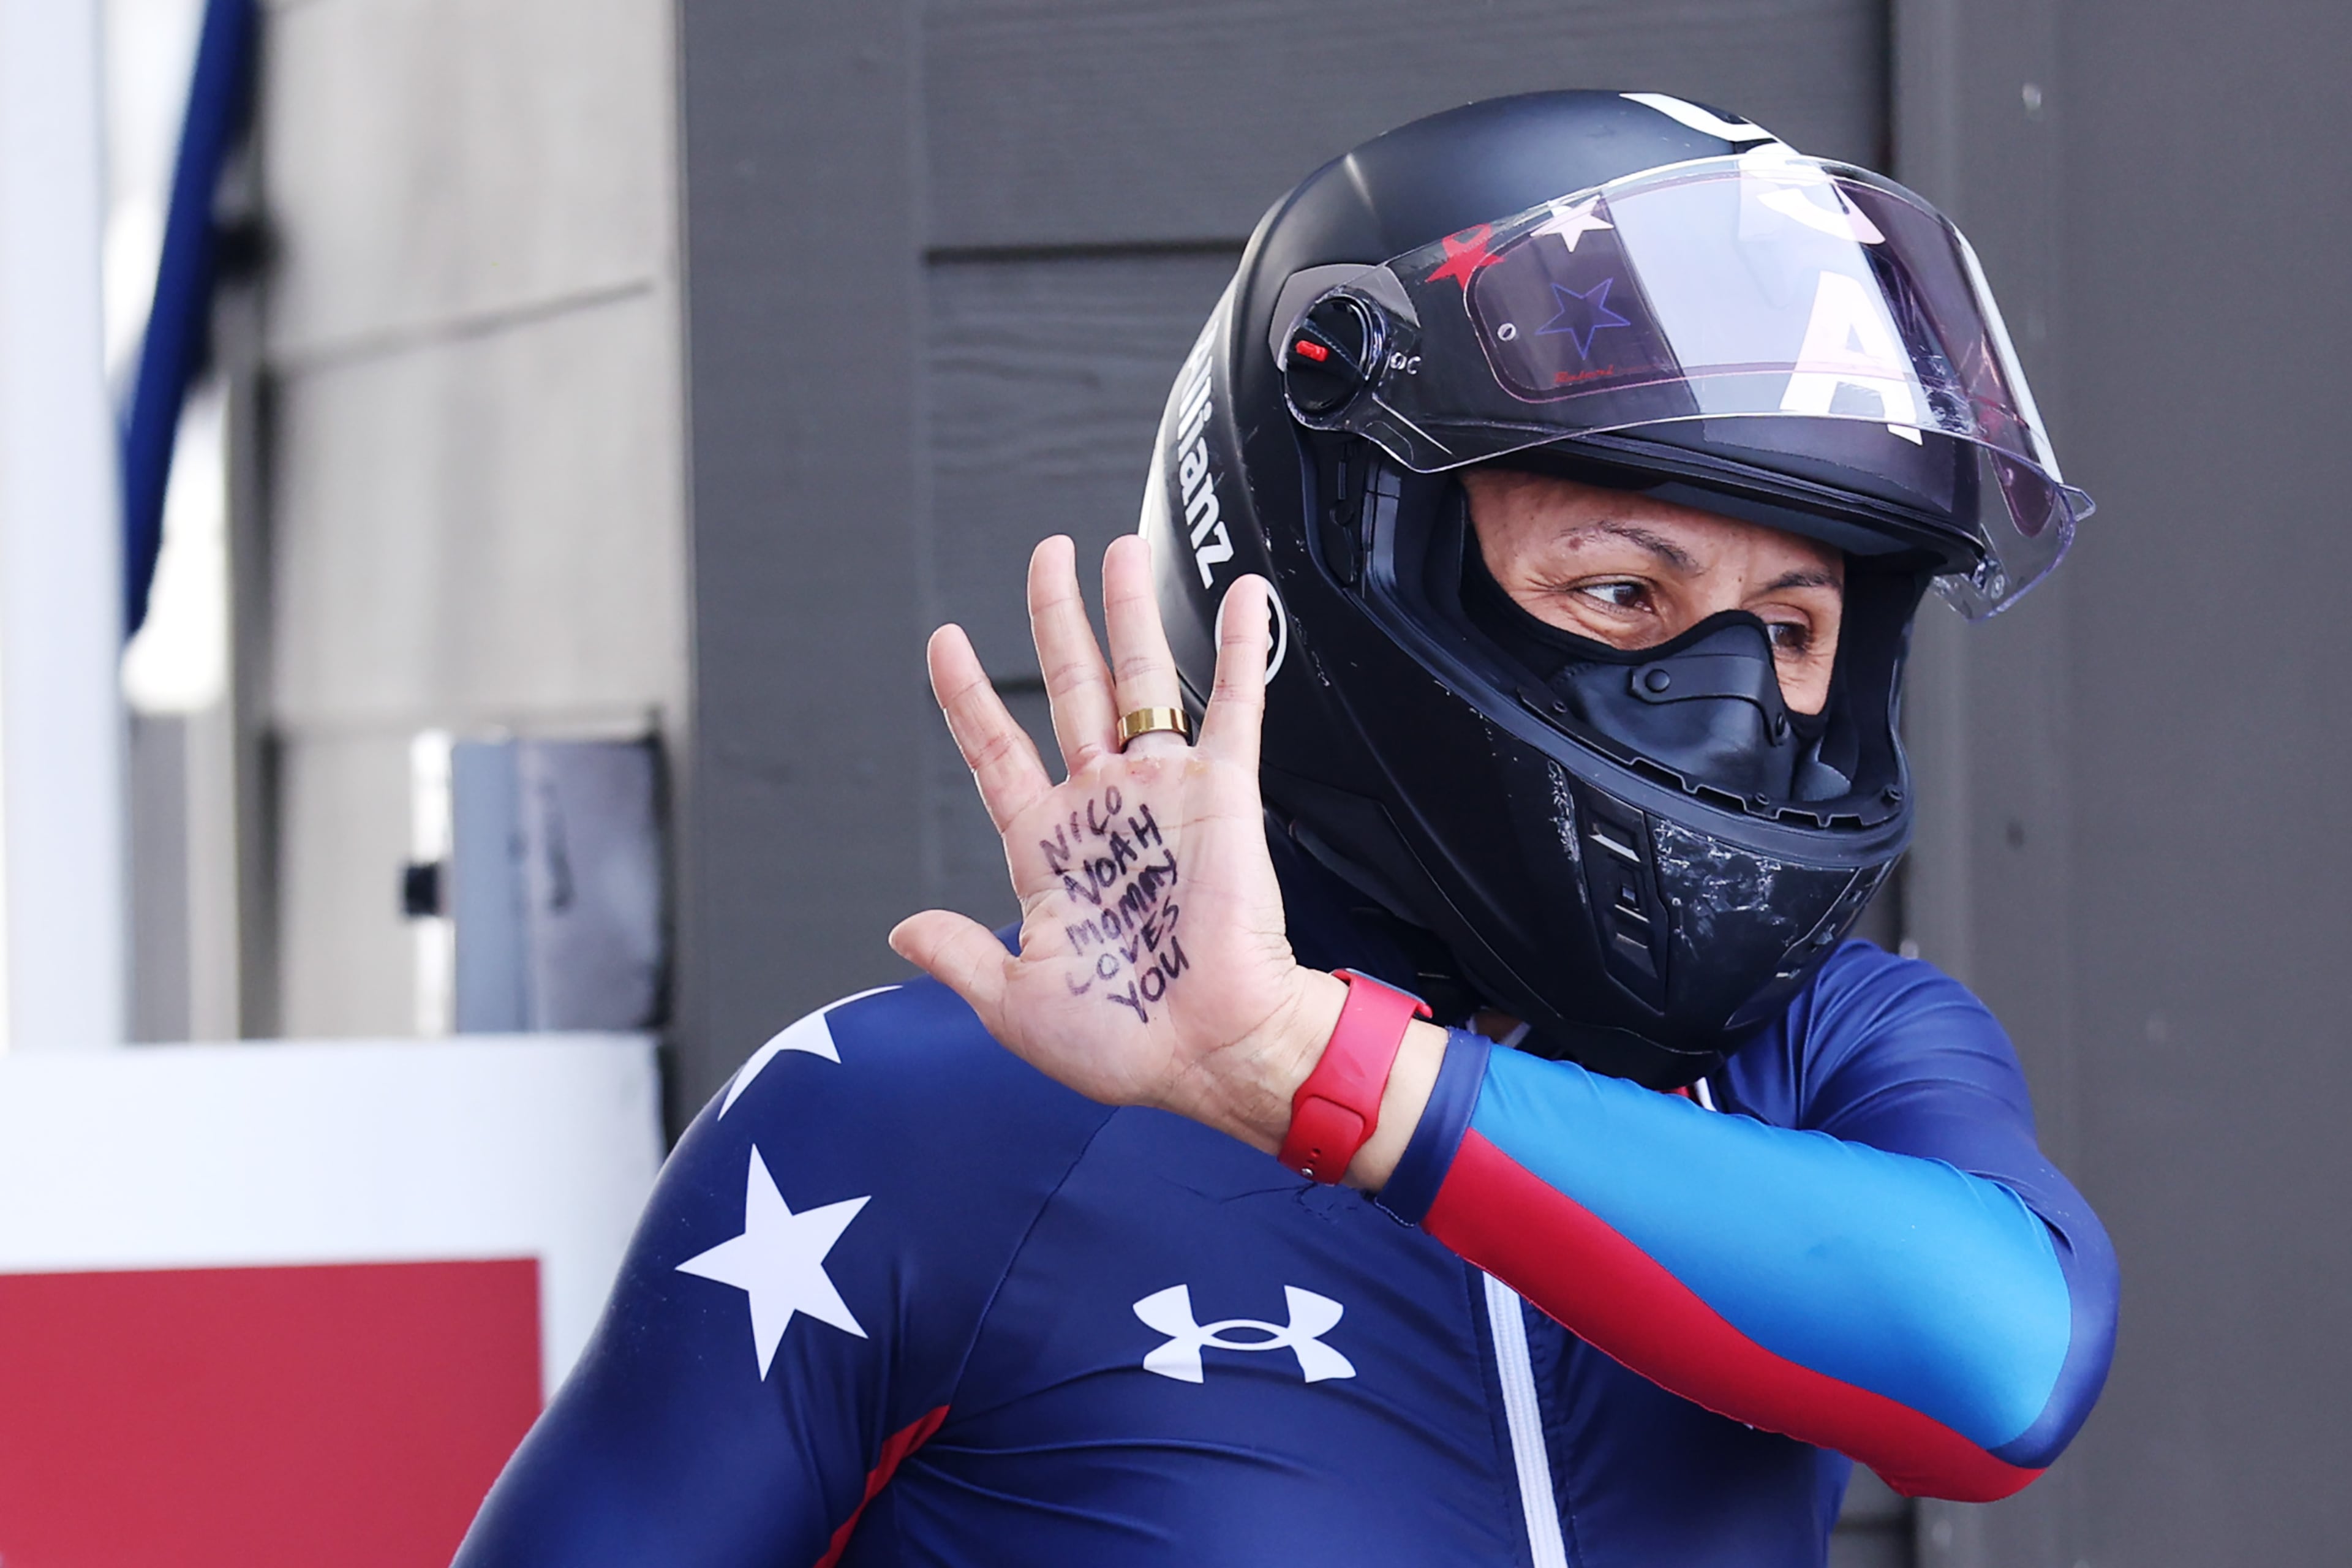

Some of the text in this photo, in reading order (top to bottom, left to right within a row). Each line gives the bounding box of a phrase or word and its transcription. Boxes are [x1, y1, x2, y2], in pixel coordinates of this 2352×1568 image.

[1039, 785, 1122, 876] NICO
[1063, 803, 1163, 905] NOAH
[1065, 848, 1177, 956] MOMMY
[1066, 895, 1180, 996] LOVES
[1106, 935, 1189, 1023] YOU
